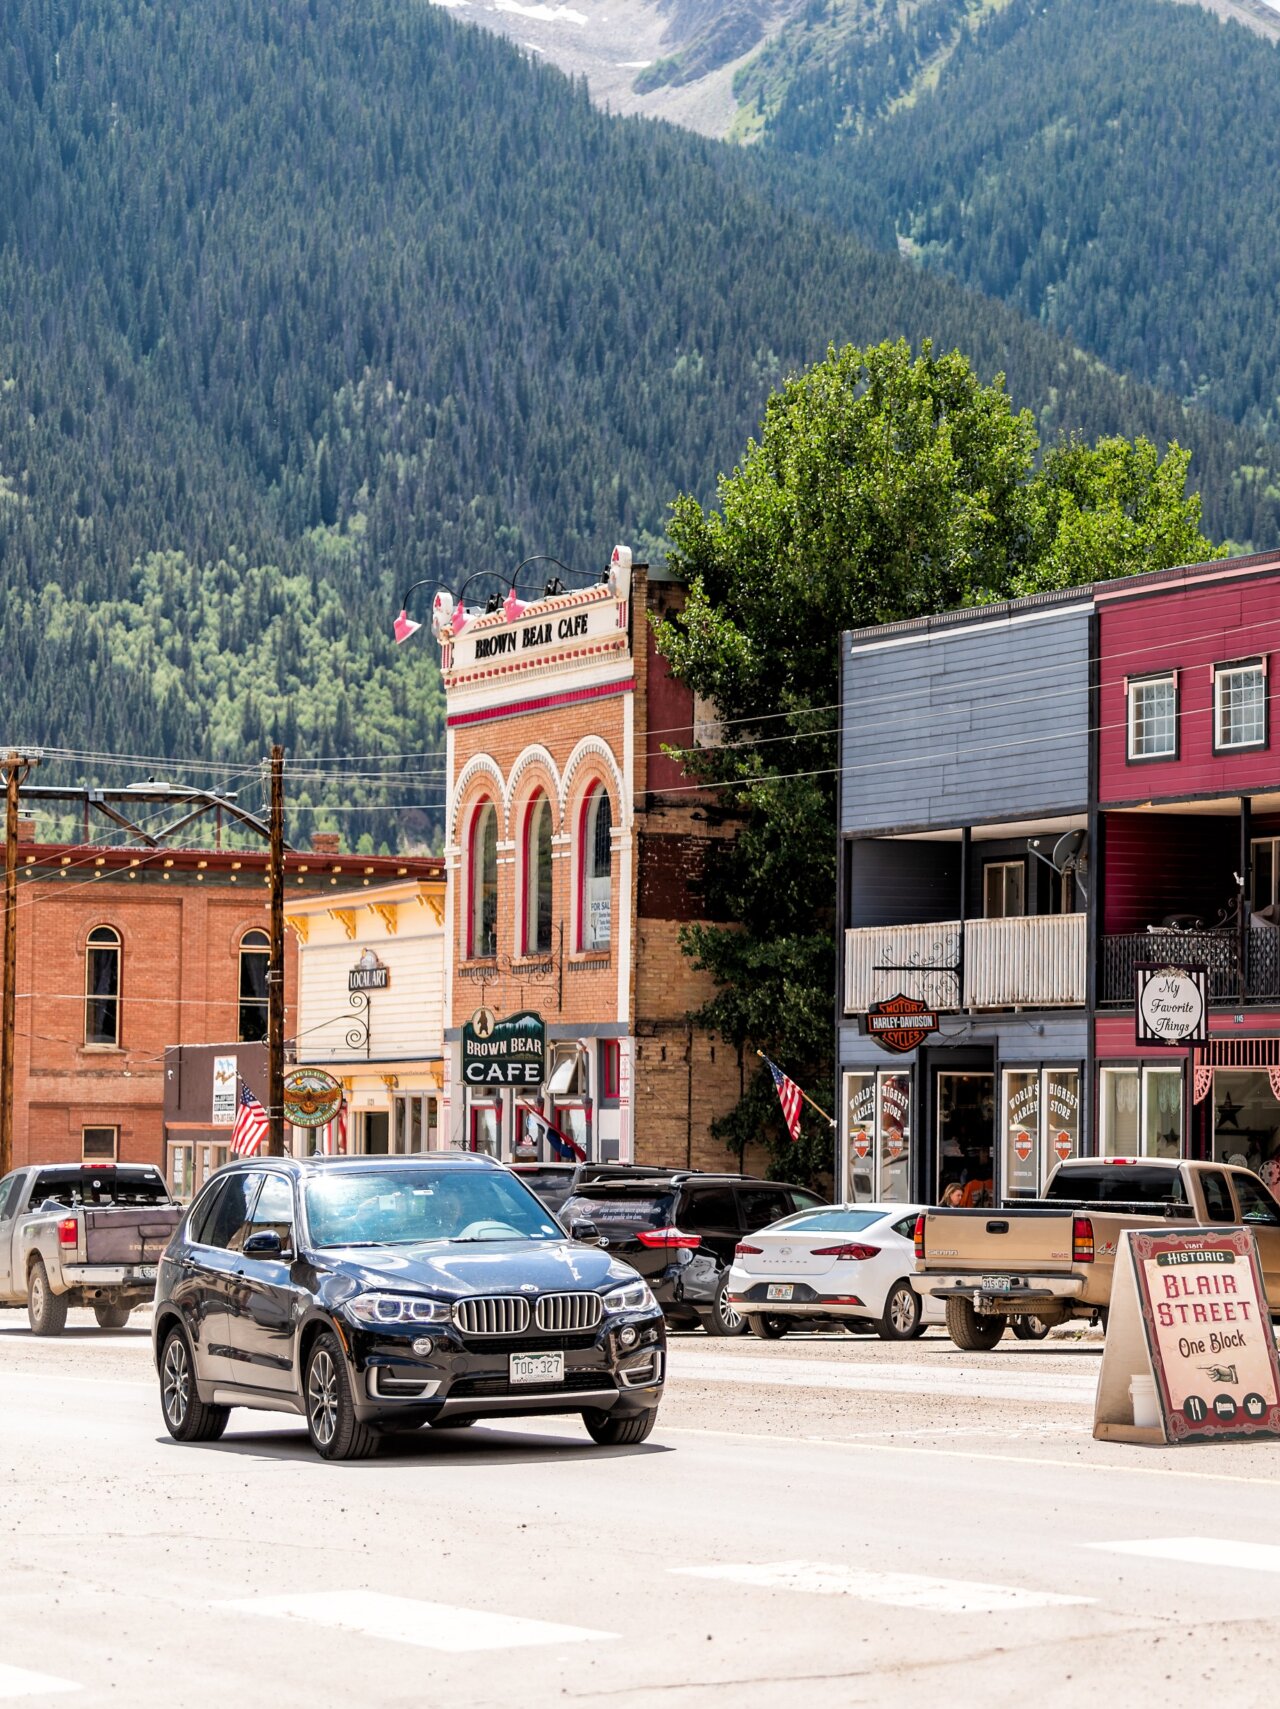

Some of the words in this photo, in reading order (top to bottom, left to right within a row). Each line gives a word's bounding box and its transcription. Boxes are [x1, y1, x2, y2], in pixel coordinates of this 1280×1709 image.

[475, 631, 517, 659] BROWN
[522, 623, 552, 648] BEAR
[558, 613, 588, 639] CAFE
[601, 901, 610, 910] SAL
[350, 971, 370, 989] LOCAL
[372, 969, 387, 987] ART
[1159, 979, 1180, 998] My
[886, 1000, 918, 1013] MOTOR
[1150, 998, 1194, 1014] Favorite
[873, 1015, 933, 1029] HARLEY-DAVIDSON
[1155, 1017, 1190, 1037] Things
[466, 1039, 507, 1057] BROWN
[511, 1037, 542, 1055] BEAR
[887, 1031, 920, 1047] CYCLES
[466, 1062, 541, 1082] CAFE
[849, 1084, 876, 1111] WORLD'S
[881, 1085, 909, 1110] HIGHEST
[1009, 1083, 1039, 1110] WORLD'S
[1049, 1083, 1079, 1110] HIGHEST
[852, 1101, 876, 1125] HARLEY
[883, 1102, 902, 1121] STORE
[1012, 1101, 1039, 1125] HARLEY
[1050, 1100, 1071, 1121] STORE
[1167, 1251, 1225, 1265] HISTORIC
[1163, 1274, 1238, 1299] BLAIR
[1157, 1301, 1251, 1327] STREET
[1178, 1337, 1206, 1359] One
[1209, 1329, 1247, 1354] Block
